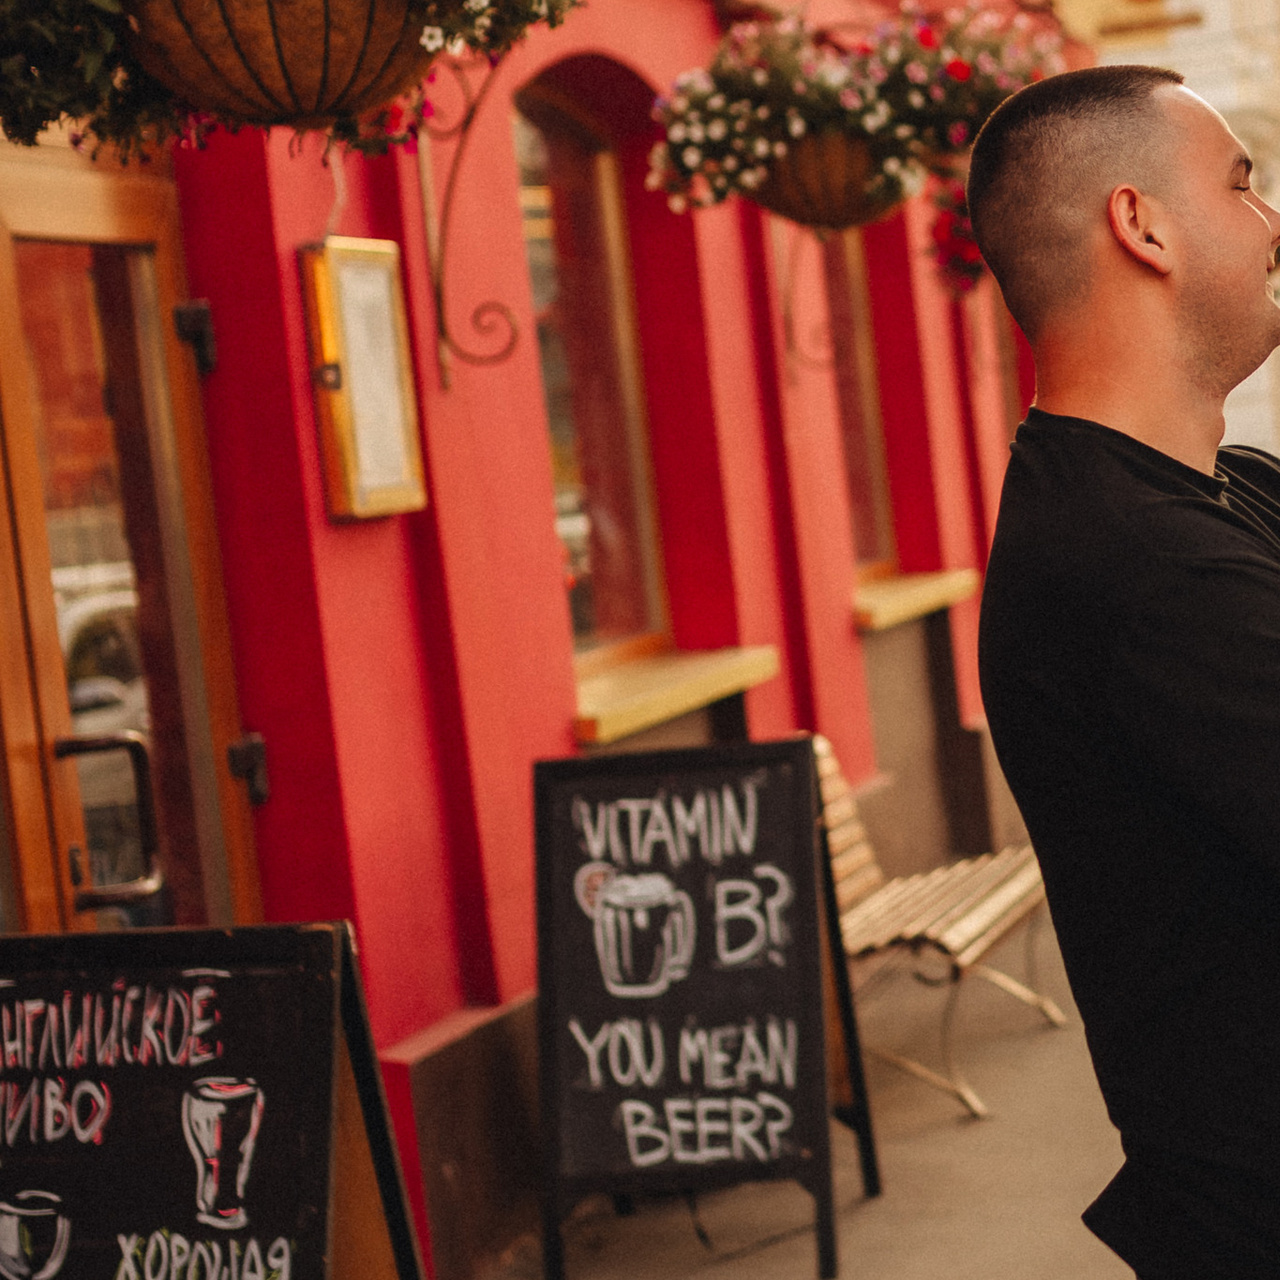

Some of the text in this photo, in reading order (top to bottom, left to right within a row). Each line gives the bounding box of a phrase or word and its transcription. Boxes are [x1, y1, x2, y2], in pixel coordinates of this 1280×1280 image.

[575, 784, 758, 868] VITAMIN
[714, 865, 793, 966] B?
[0, 977, 223, 1070] НГЛИЙСКОЕ
[568, 1016, 797, 1090] YOU MEAN
[0, 1075, 111, 1147] ИВО
[620, 1091, 794, 1168] BEER?
